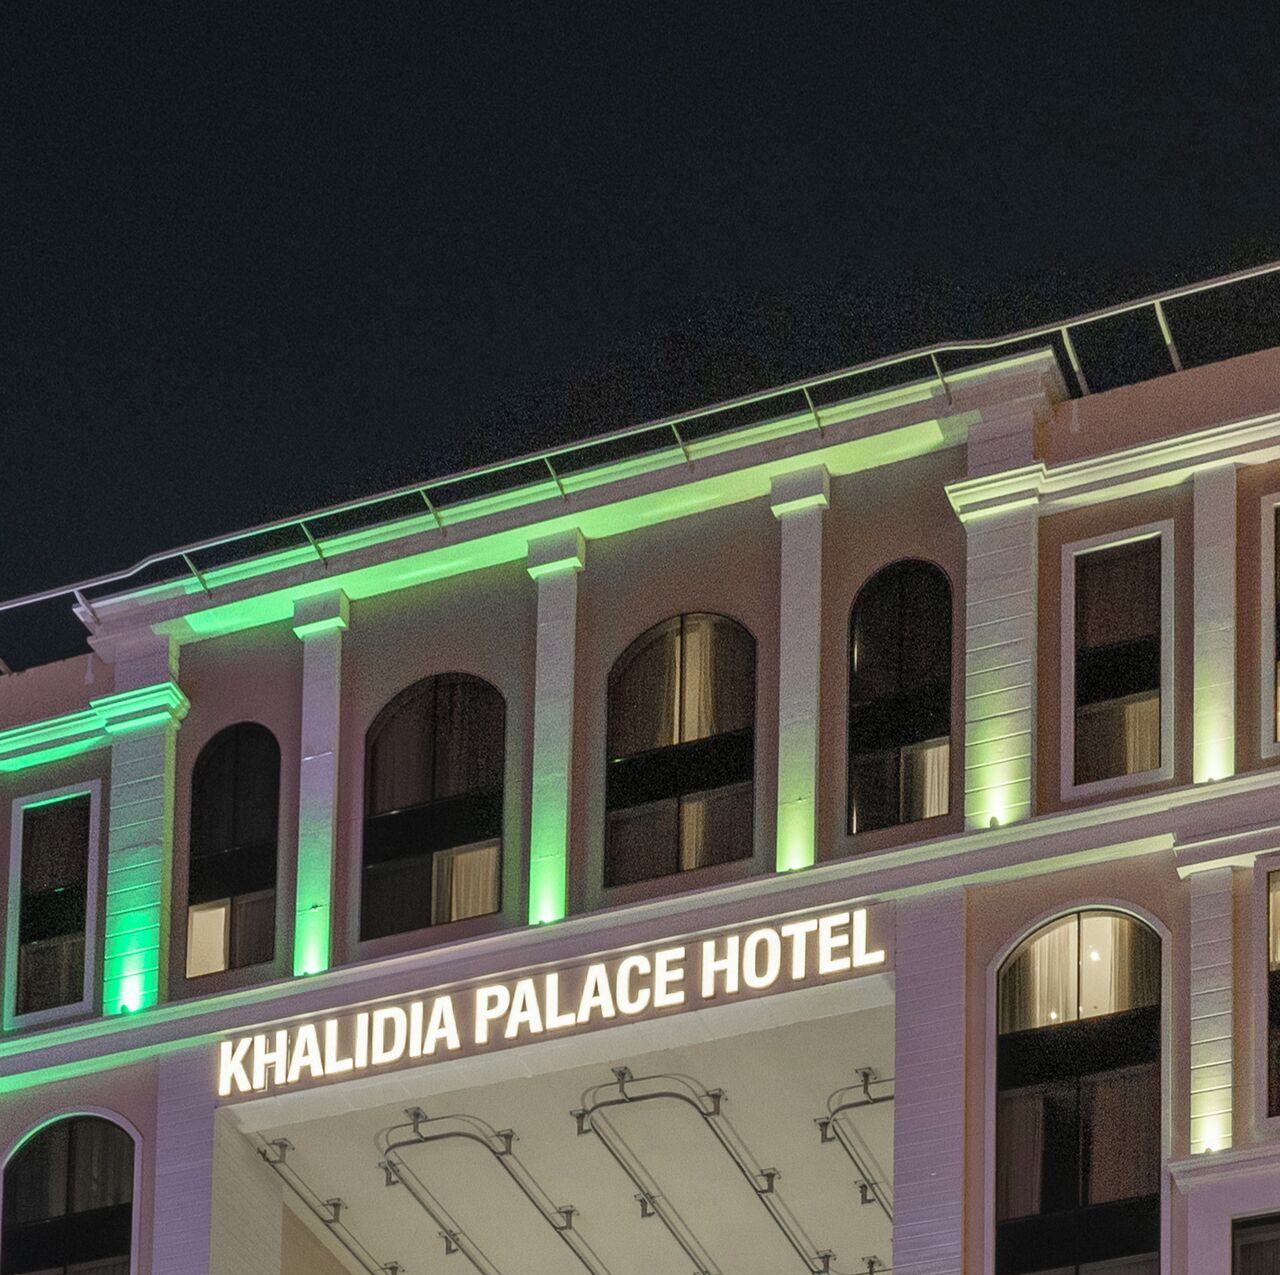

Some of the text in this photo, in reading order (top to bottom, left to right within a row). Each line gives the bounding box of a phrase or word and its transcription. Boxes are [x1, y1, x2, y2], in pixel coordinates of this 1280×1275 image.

[219, 908, 885, 1096] KHALIDIA PALACE HOTEL
